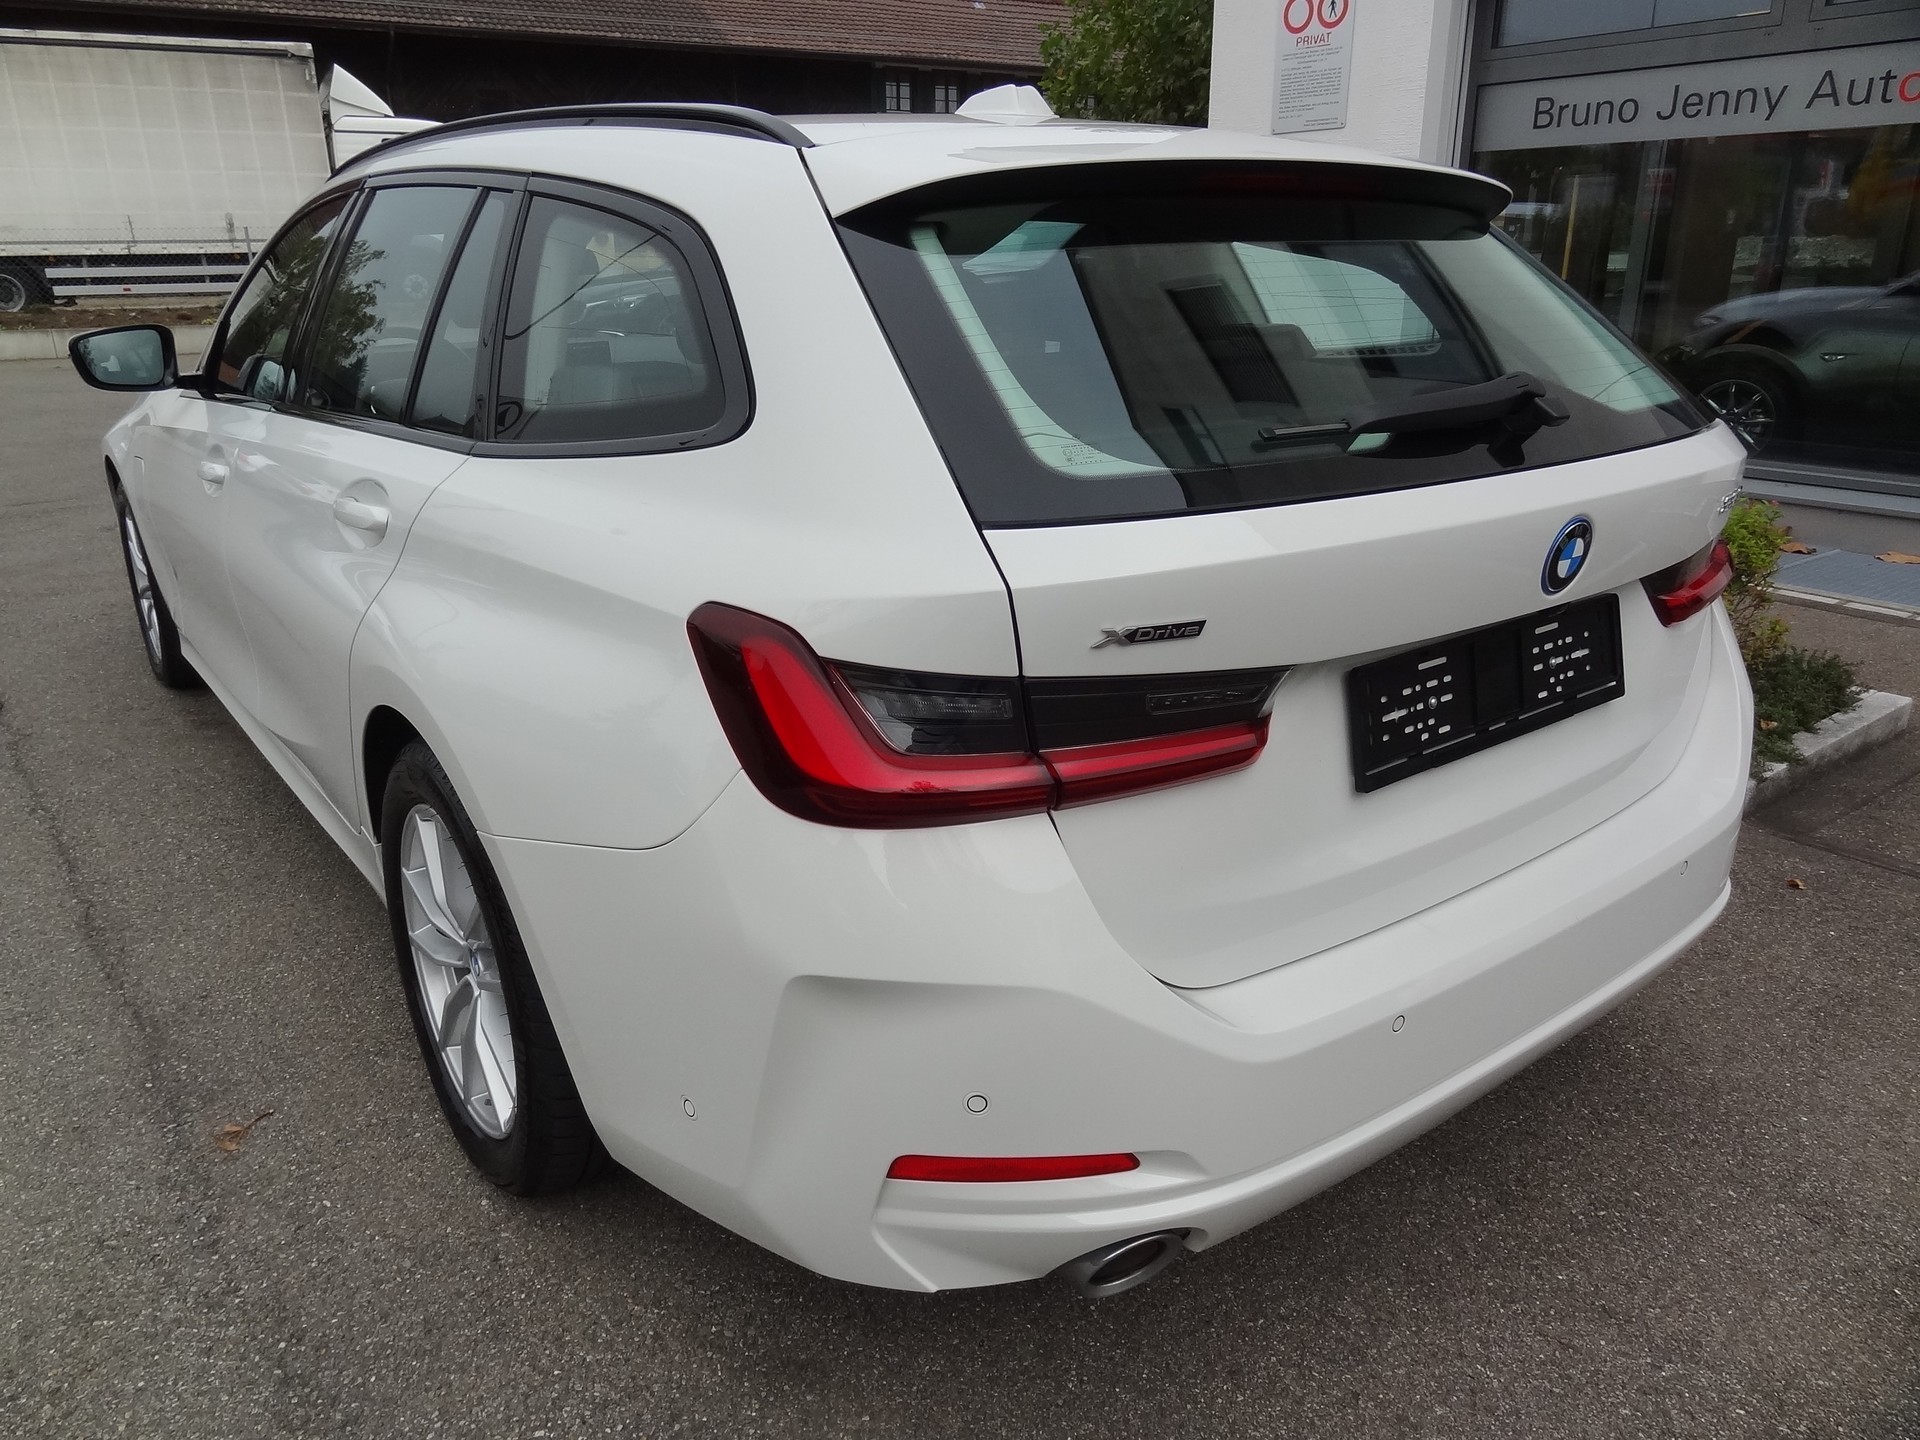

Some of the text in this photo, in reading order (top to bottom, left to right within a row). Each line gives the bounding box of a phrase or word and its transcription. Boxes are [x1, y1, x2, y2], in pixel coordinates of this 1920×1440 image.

[1296, 32, 1332, 46] PRIVAT
[1532, 96, 1640, 130] Bruno
[1656, 84, 1789, 121] Jenny
